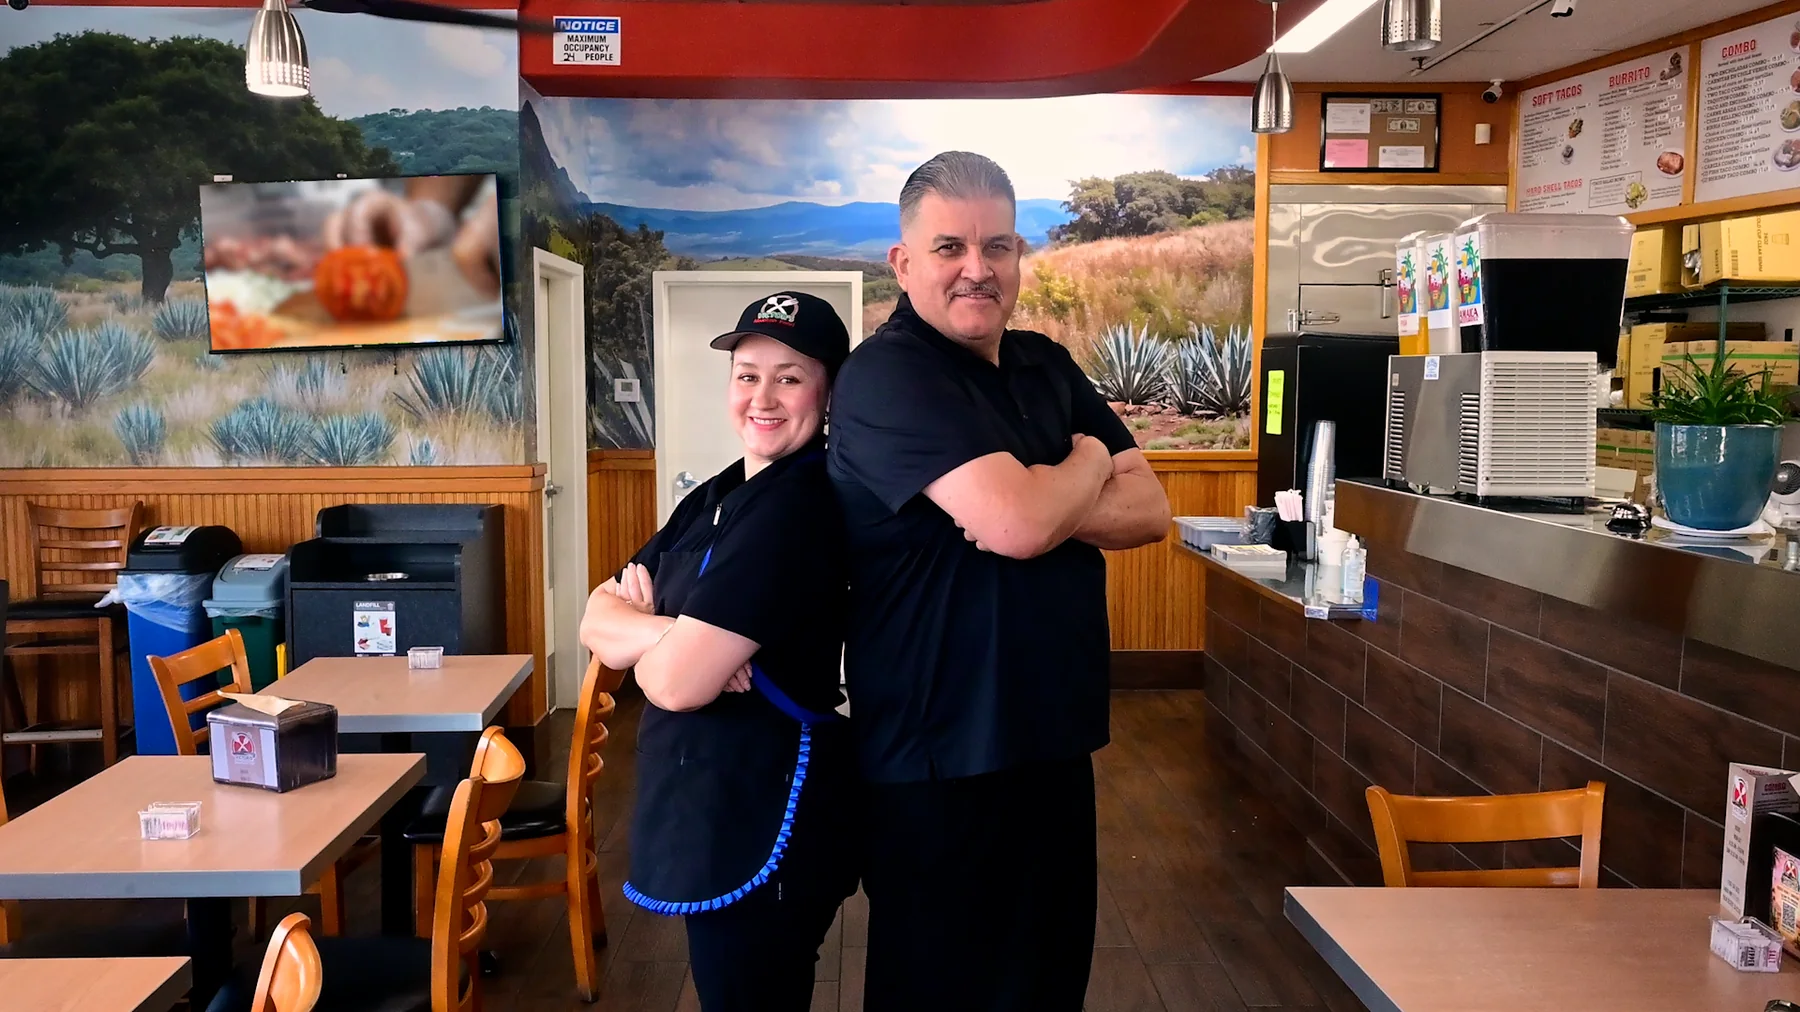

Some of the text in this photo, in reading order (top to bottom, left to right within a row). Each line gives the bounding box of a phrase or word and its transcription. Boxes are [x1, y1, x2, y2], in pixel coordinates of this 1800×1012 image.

[560, 21, 616, 31] NOTICE
[564, 44, 609, 52] OCCUPANCY
[1722, 39, 1756, 58] COMBO
[563, 53, 575, 61] 24
[1609, 67, 1650, 87] BURRITO
[1532, 92, 1553, 106] SOFT
[1556, 84, 1582, 100] TACOS
[1543, 183, 1561, 193] SHELL
[1563, 179, 1582, 190] TACOS
